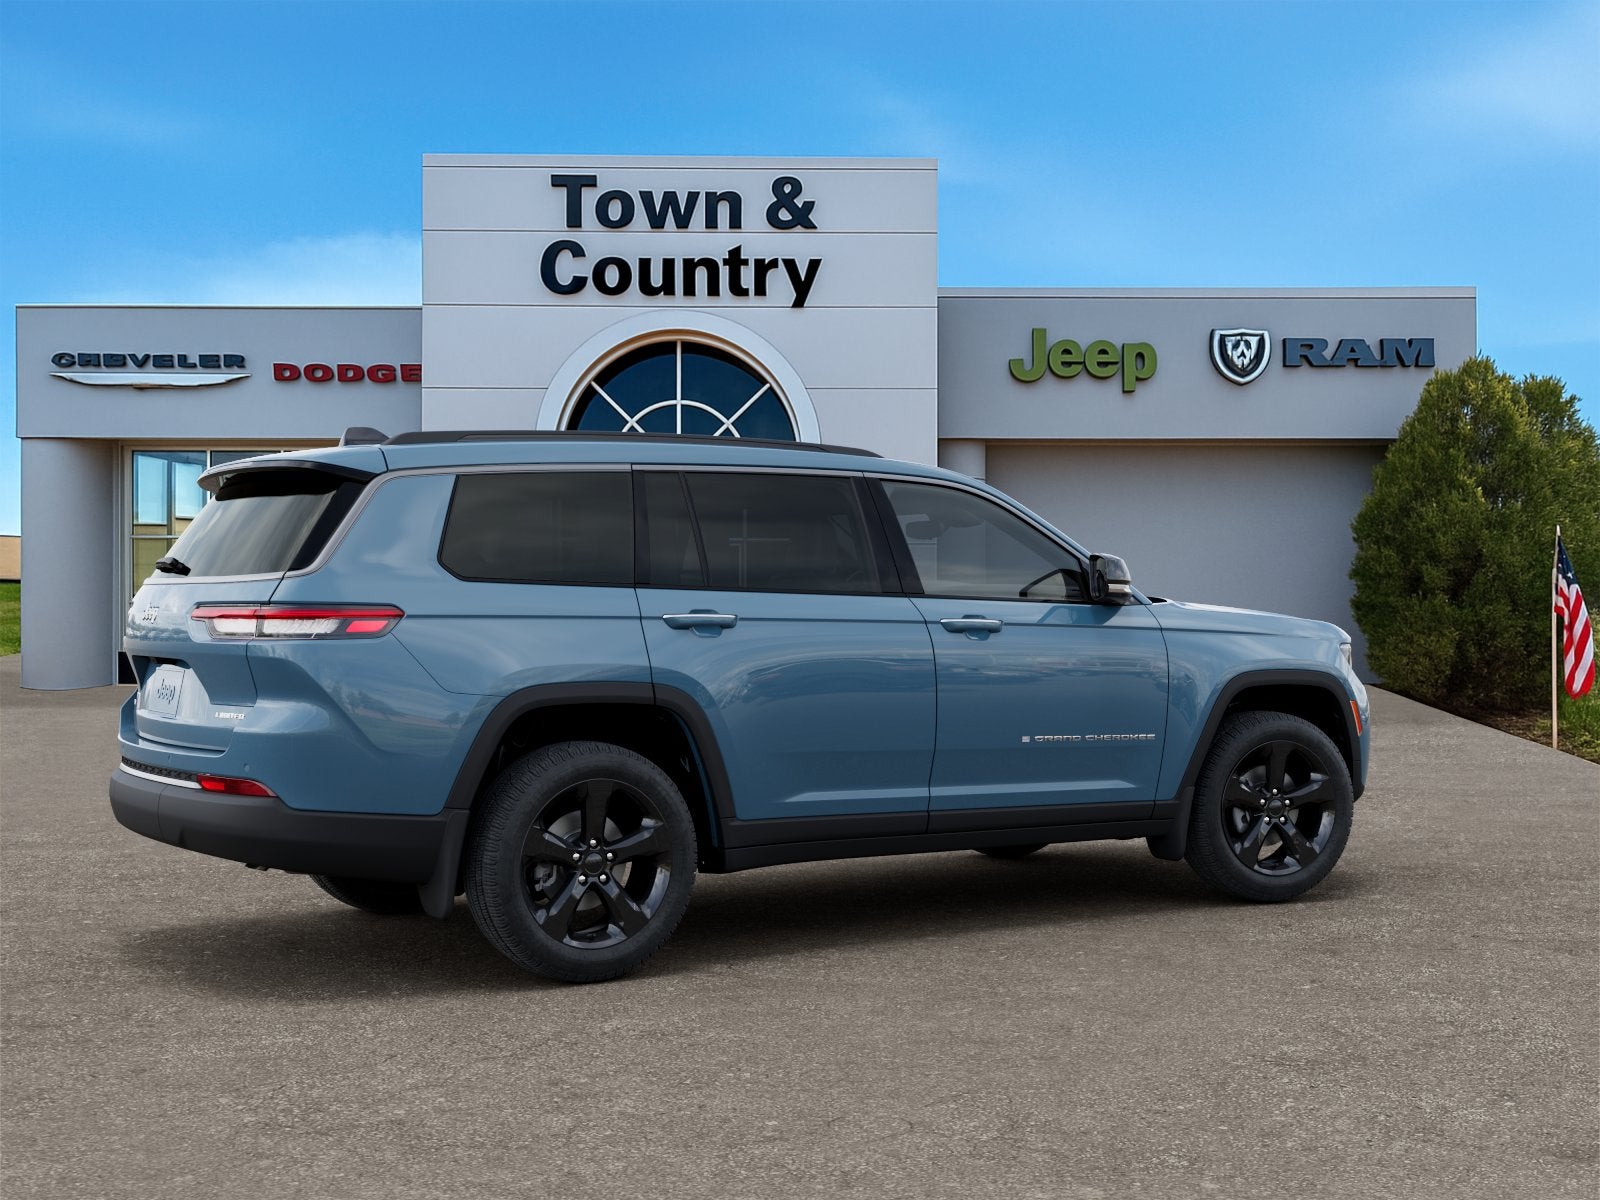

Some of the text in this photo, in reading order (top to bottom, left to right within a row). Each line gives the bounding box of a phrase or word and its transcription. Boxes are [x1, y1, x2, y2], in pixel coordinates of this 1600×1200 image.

[550, 173, 818, 230] Town &
[540, 239, 822, 308] Country
[273, 362, 422, 383] DODGE
[1009, 327, 1158, 393] Jeep
[1283, 337, 1436, 368] RAM
[1085, 733, 1156, 741] CHEROKEE
